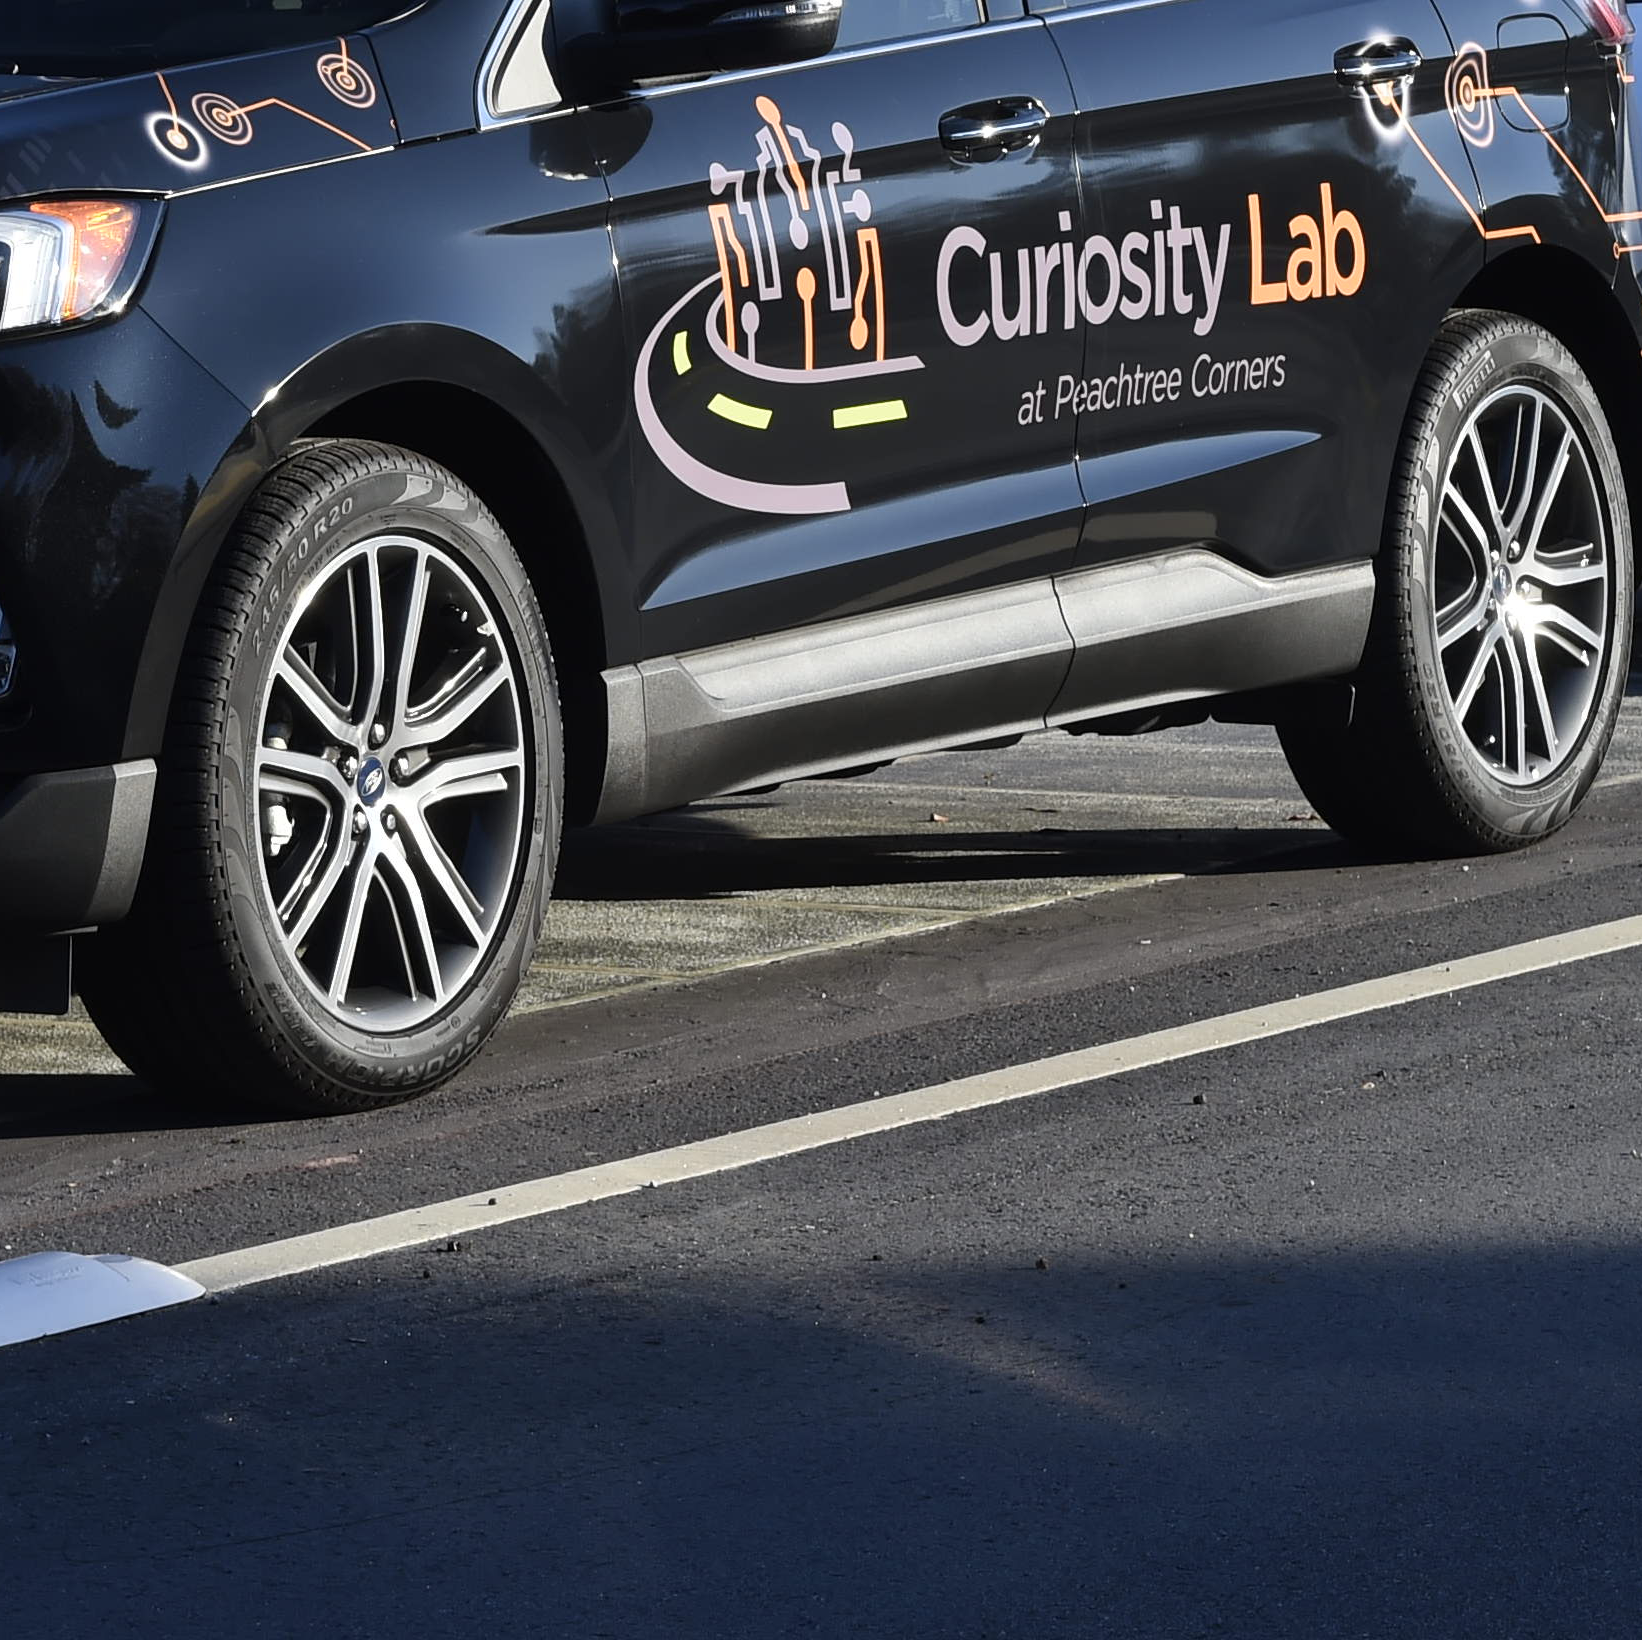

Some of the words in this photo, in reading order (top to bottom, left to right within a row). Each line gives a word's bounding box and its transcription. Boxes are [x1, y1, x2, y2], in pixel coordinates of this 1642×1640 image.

[936, 199, 1231, 348] Curiosity
[1247, 182, 1367, 306] Lab
[1017, 381, 1046, 427] at
[1054, 363, 1183, 418] Peachtree
[1191, 354, 1287, 398] Corners
[1452, 349, 1496, 411] PIRELLI
